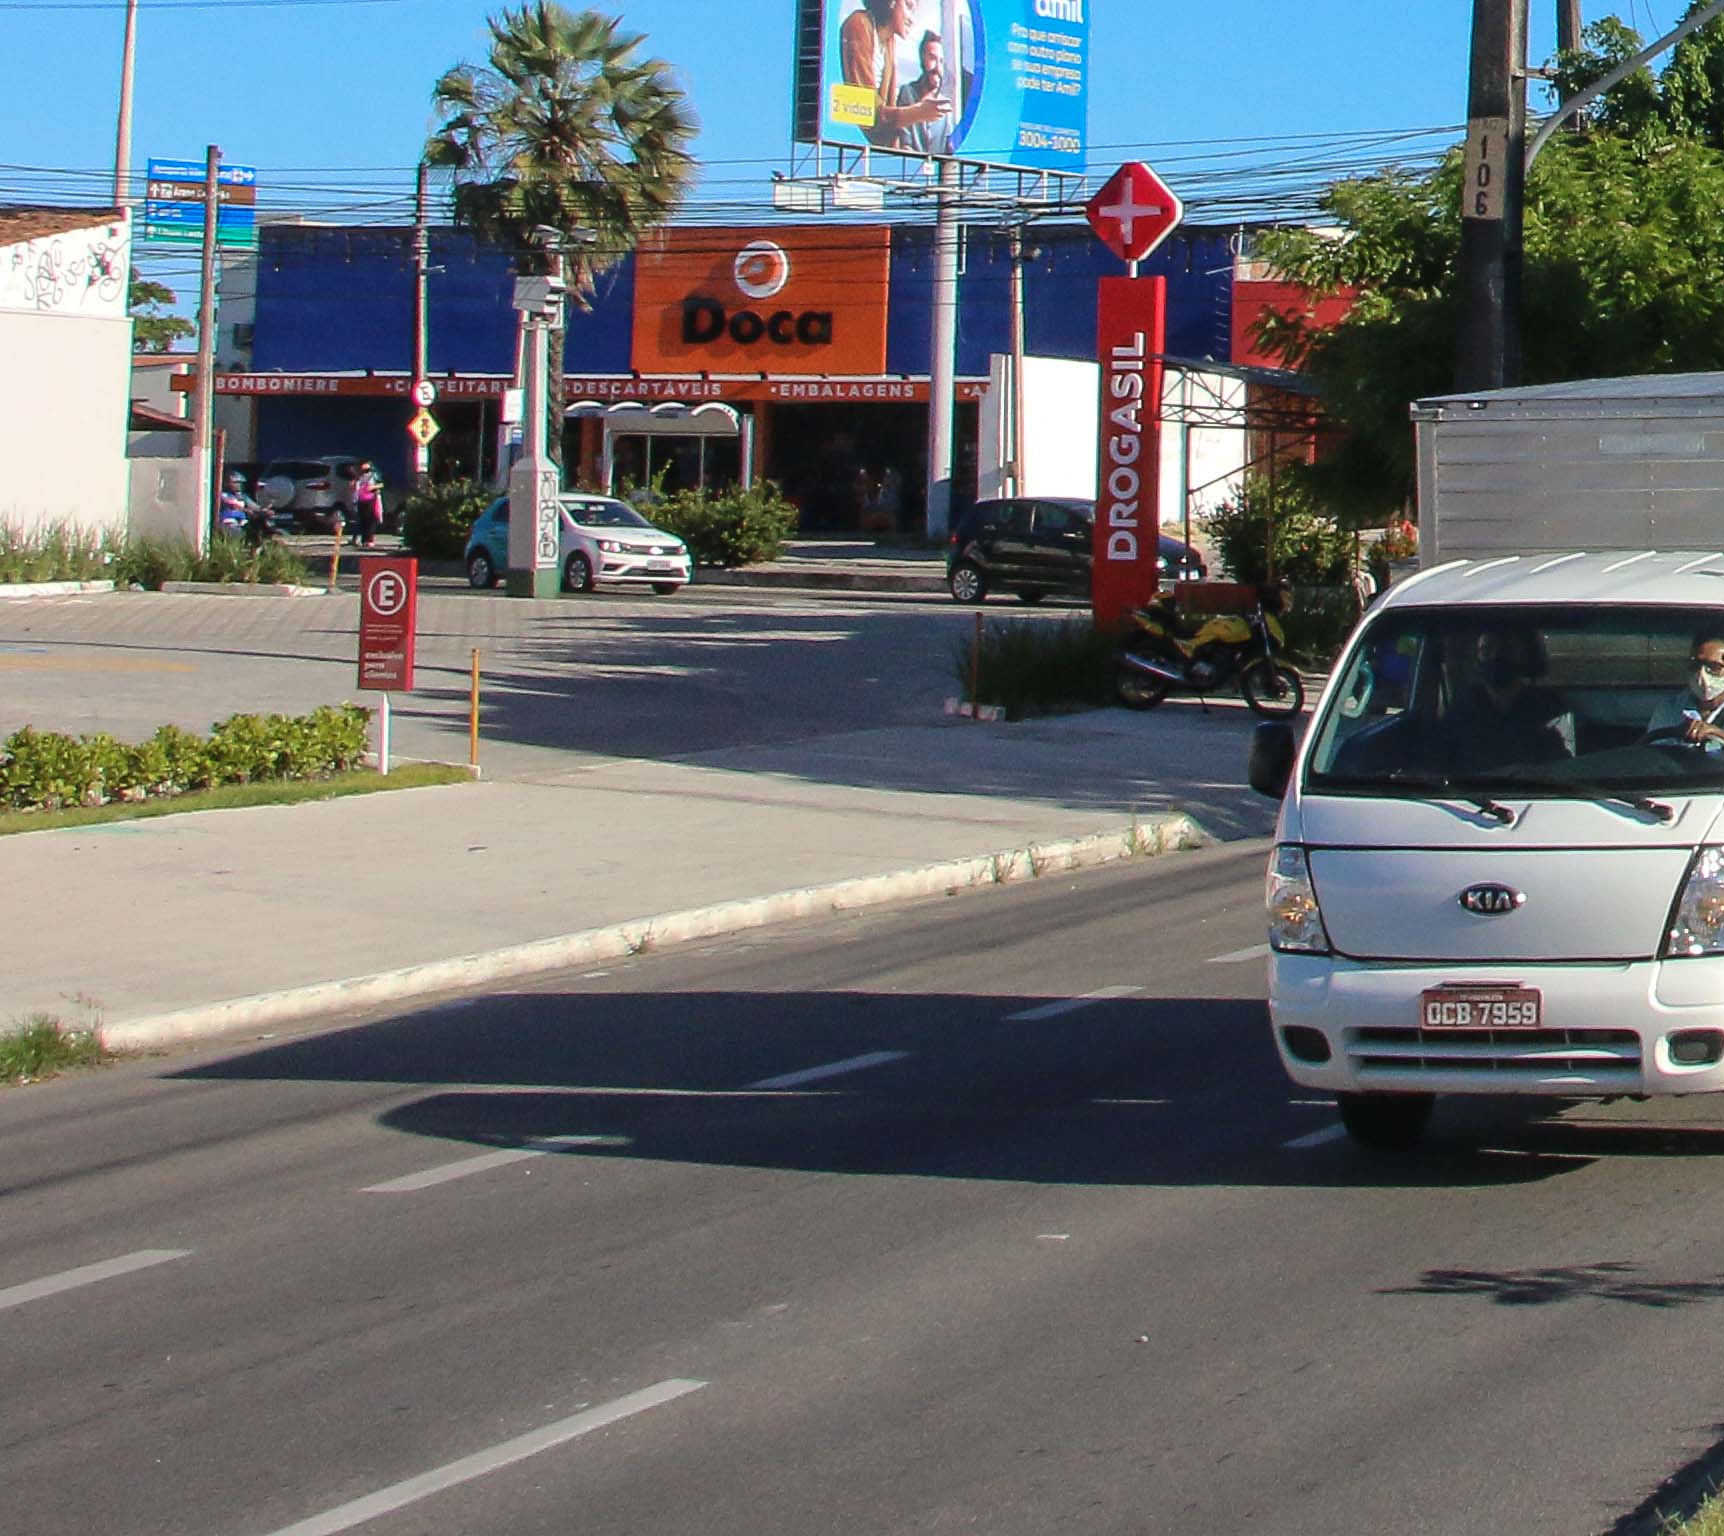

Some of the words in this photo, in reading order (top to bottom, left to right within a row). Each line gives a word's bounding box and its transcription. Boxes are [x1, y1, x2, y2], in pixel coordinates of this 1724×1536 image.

[842, 102, 873, 117] vidas
[1475, 135, 1491, 215] 106
[682, 296, 832, 345] Doca
[214, 378, 339, 392] BOMBONIERE
[573, 381, 722, 396] DESCARTÁVEIS
[779, 384, 915, 398] EMBALAGENS
[1107, 331, 1146, 560] DROGASIL
[379, 579, 395, 606] E
[1467, 890, 1512, 910] KIA
